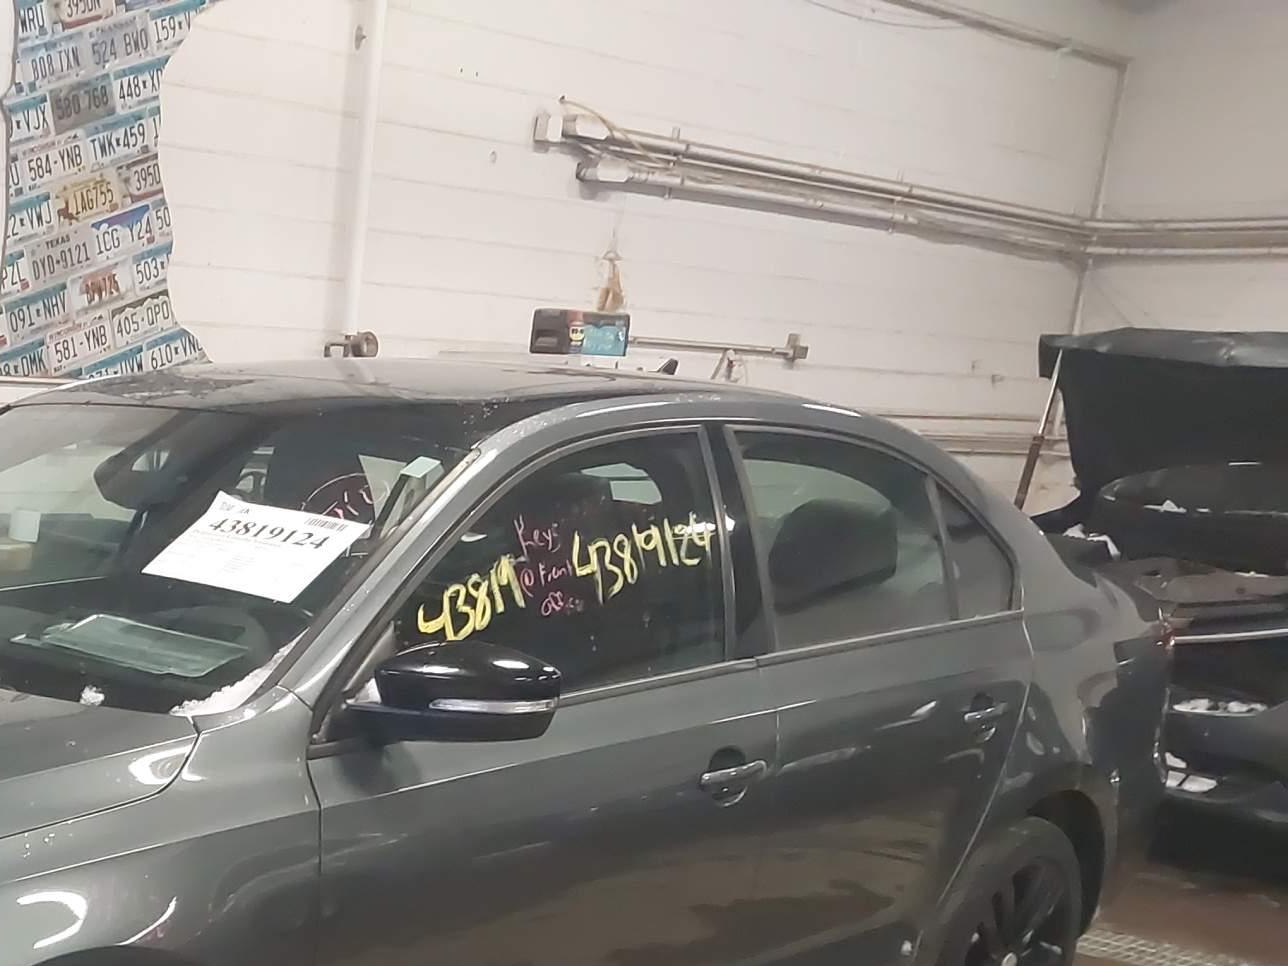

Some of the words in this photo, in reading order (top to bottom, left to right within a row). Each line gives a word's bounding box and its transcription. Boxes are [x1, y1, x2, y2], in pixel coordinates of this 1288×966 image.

[45, 234, 71, 250] TEXAS
[209, 518, 330, 549] 43819124
[571, 511, 716, 606] 43819124
